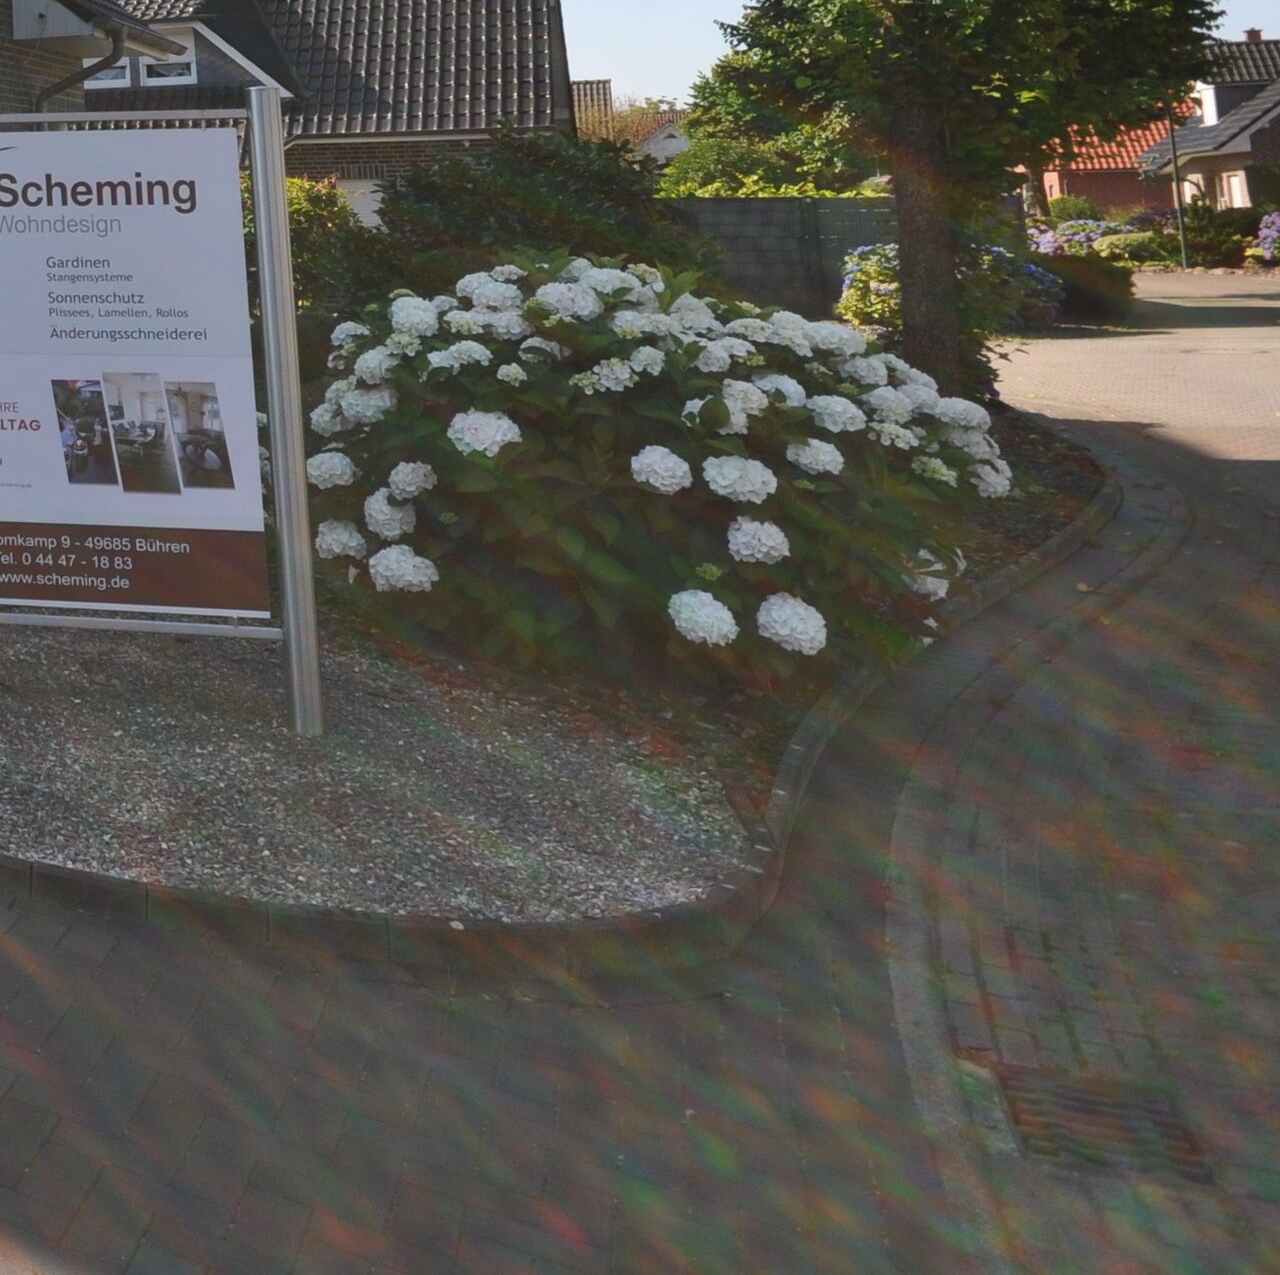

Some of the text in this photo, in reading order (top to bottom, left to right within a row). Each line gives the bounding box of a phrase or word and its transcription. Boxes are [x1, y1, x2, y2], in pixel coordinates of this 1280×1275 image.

[46, 256, 110, 269] Gardinen
[46, 272, 133, 284] Stangensysteme
[48, 291, 145, 304] Sonnenschutz
[48, 307, 189, 319] Plissees, Lamellen, Rollos
[50, 325, 208, 342] Änderungsschneiderei
[60, 535, 71, 548] 9
[84, 536, 131, 552] 49685
[135, 538, 191, 554] Bühren
[21, 552, 32, 566] 0
[35, 553, 53, 566] 44
[58, 553, 76, 567] 47
[91, 555, 110, 569] 18
[114, 556, 133, 570] 83
